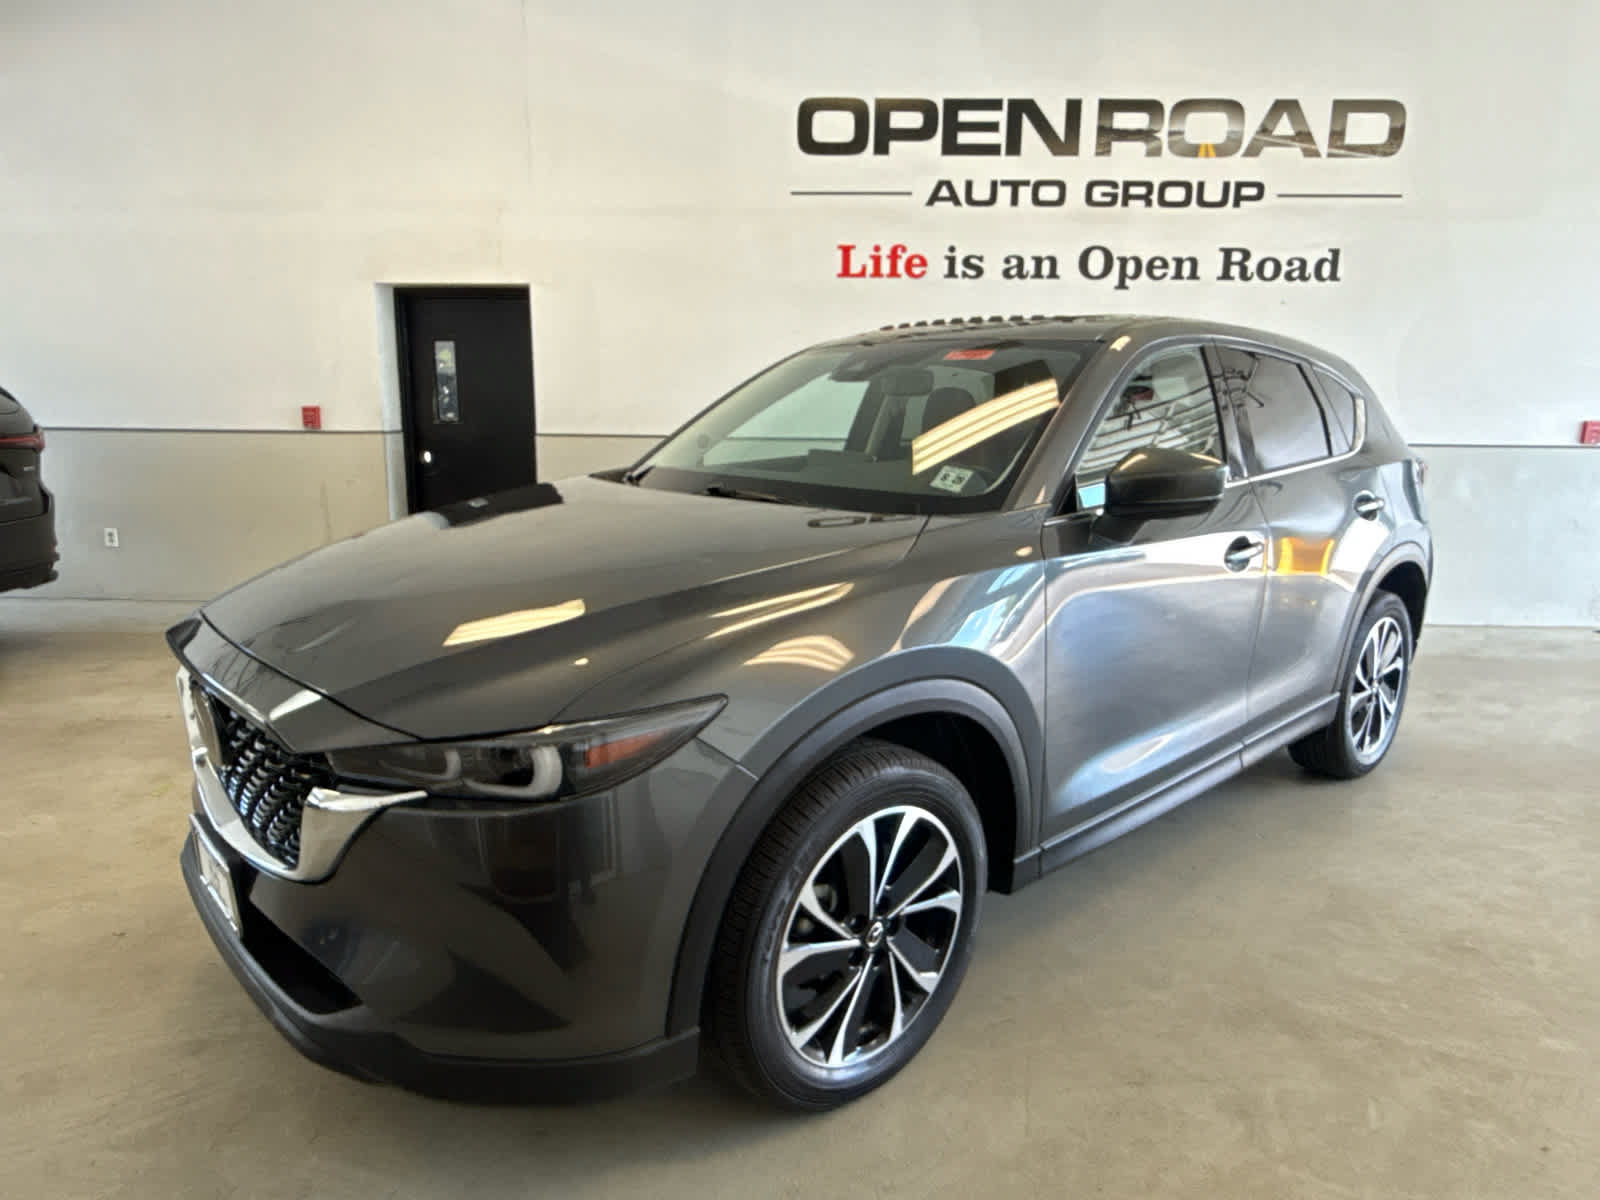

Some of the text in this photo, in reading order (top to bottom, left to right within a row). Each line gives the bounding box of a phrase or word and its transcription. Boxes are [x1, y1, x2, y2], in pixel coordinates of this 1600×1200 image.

[796, 96, 1408, 159] OPEN ROAD
[925, 179, 1266, 209] AUTO GROUP
[836, 244, 1341, 291] Life is an Open Road
